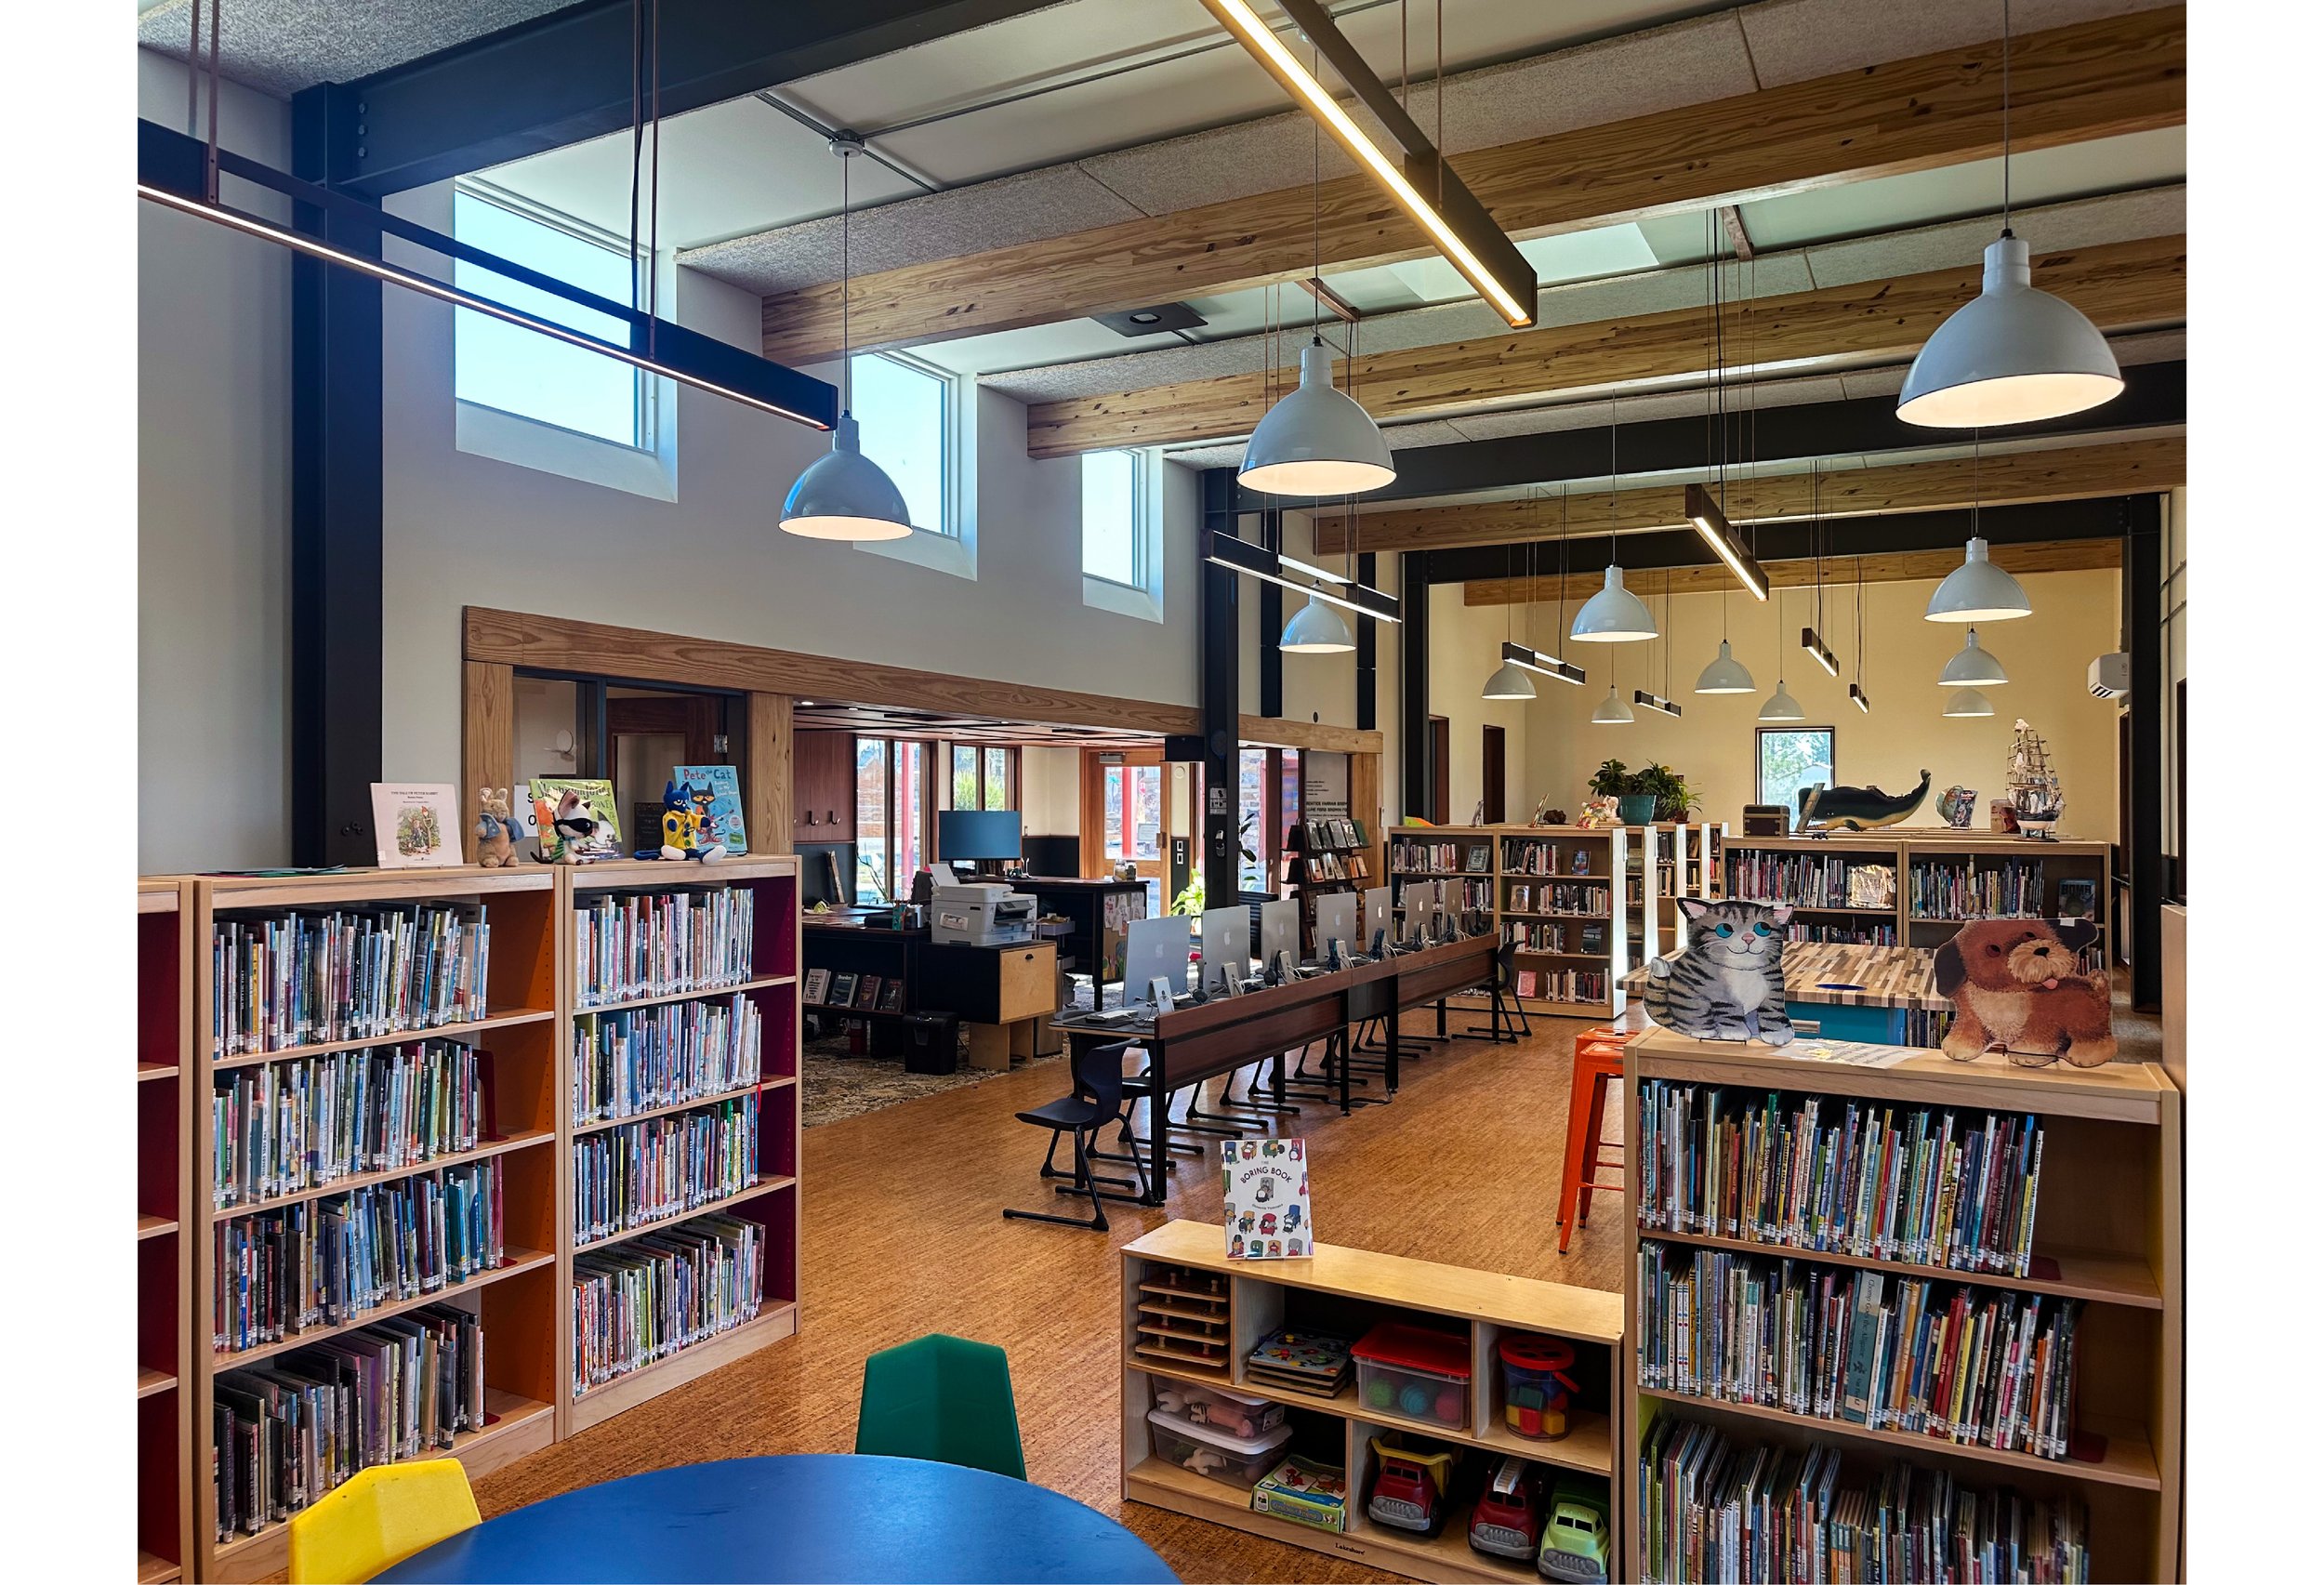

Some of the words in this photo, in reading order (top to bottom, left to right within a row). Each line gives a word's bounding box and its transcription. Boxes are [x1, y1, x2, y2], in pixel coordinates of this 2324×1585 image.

[683, 769, 706, 780] Pete
[713, 769, 732, 779] Cat
[1240, 1167, 1269, 1183] BORING
[1271, 1167, 1292, 1182] BOOK
[1865, 1279, 1875, 1301] Chomp
[1862, 1301, 1872, 1316] Goes
[1861, 1320, 1869, 1329] the
[1857, 1332, 1868, 1358] Alligator
[1335, 1542, 1366, 1556] Lakeshore
